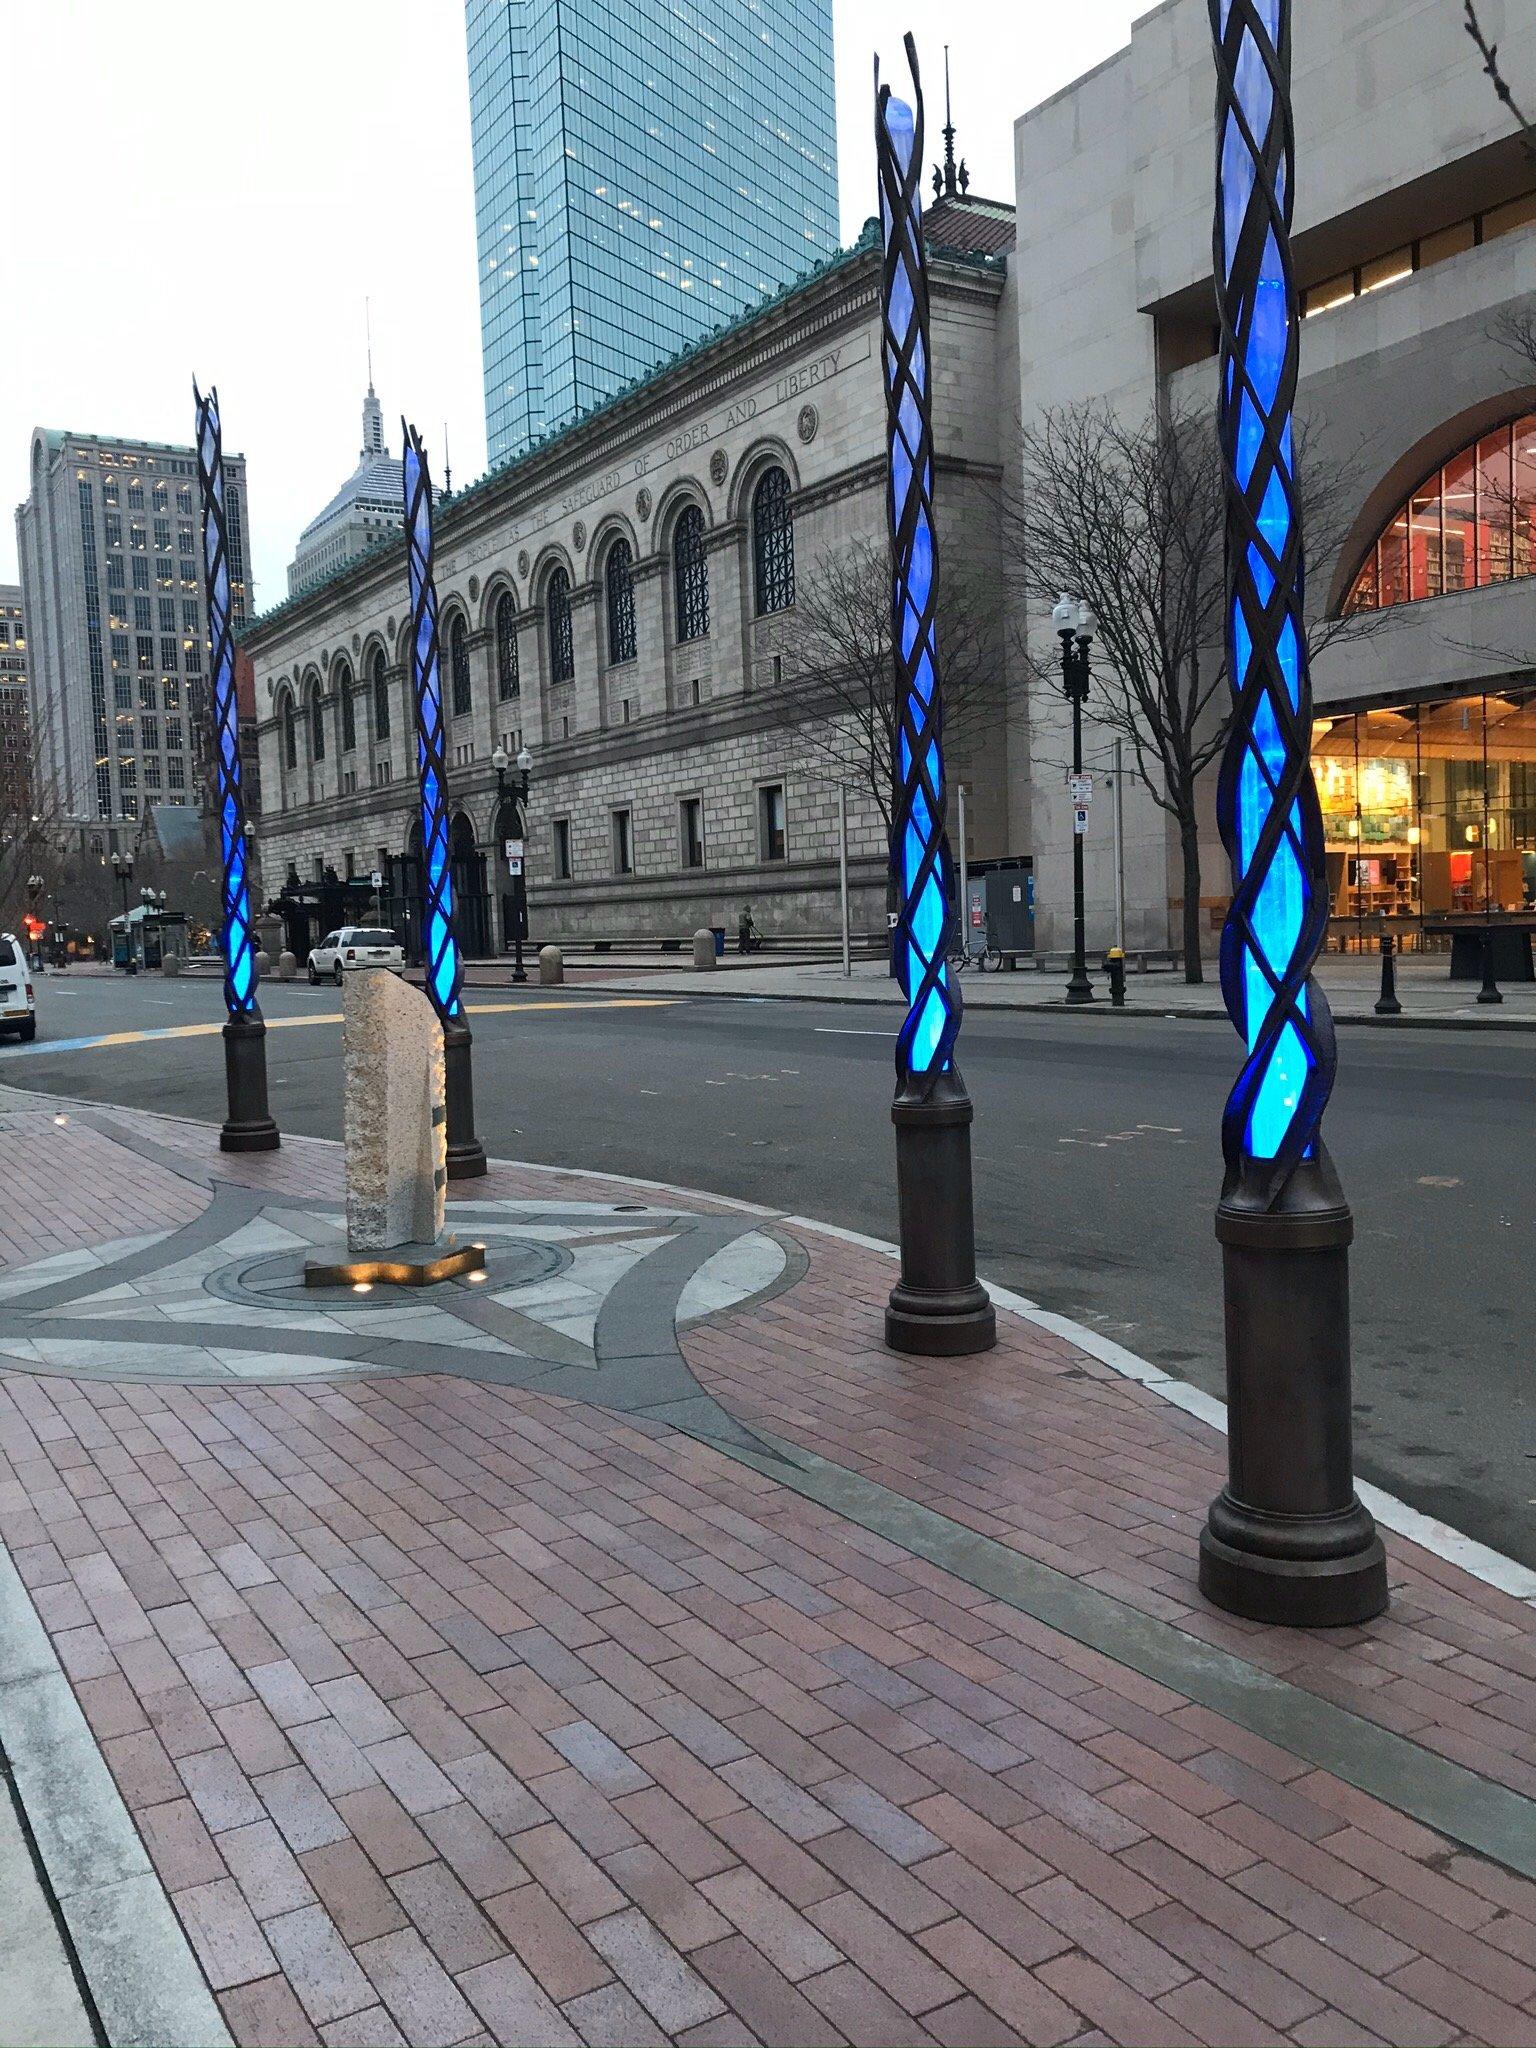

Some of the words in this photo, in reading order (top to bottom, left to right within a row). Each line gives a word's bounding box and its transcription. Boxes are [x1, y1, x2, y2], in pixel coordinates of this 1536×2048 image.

[562, 472, 620, 514] SAFEGUARD
[635, 454, 651, 475] OF
[666, 423, 711, 458] ORDER
[726, 398, 757, 428] AND
[776, 350, 842, 402] LIBERTY
